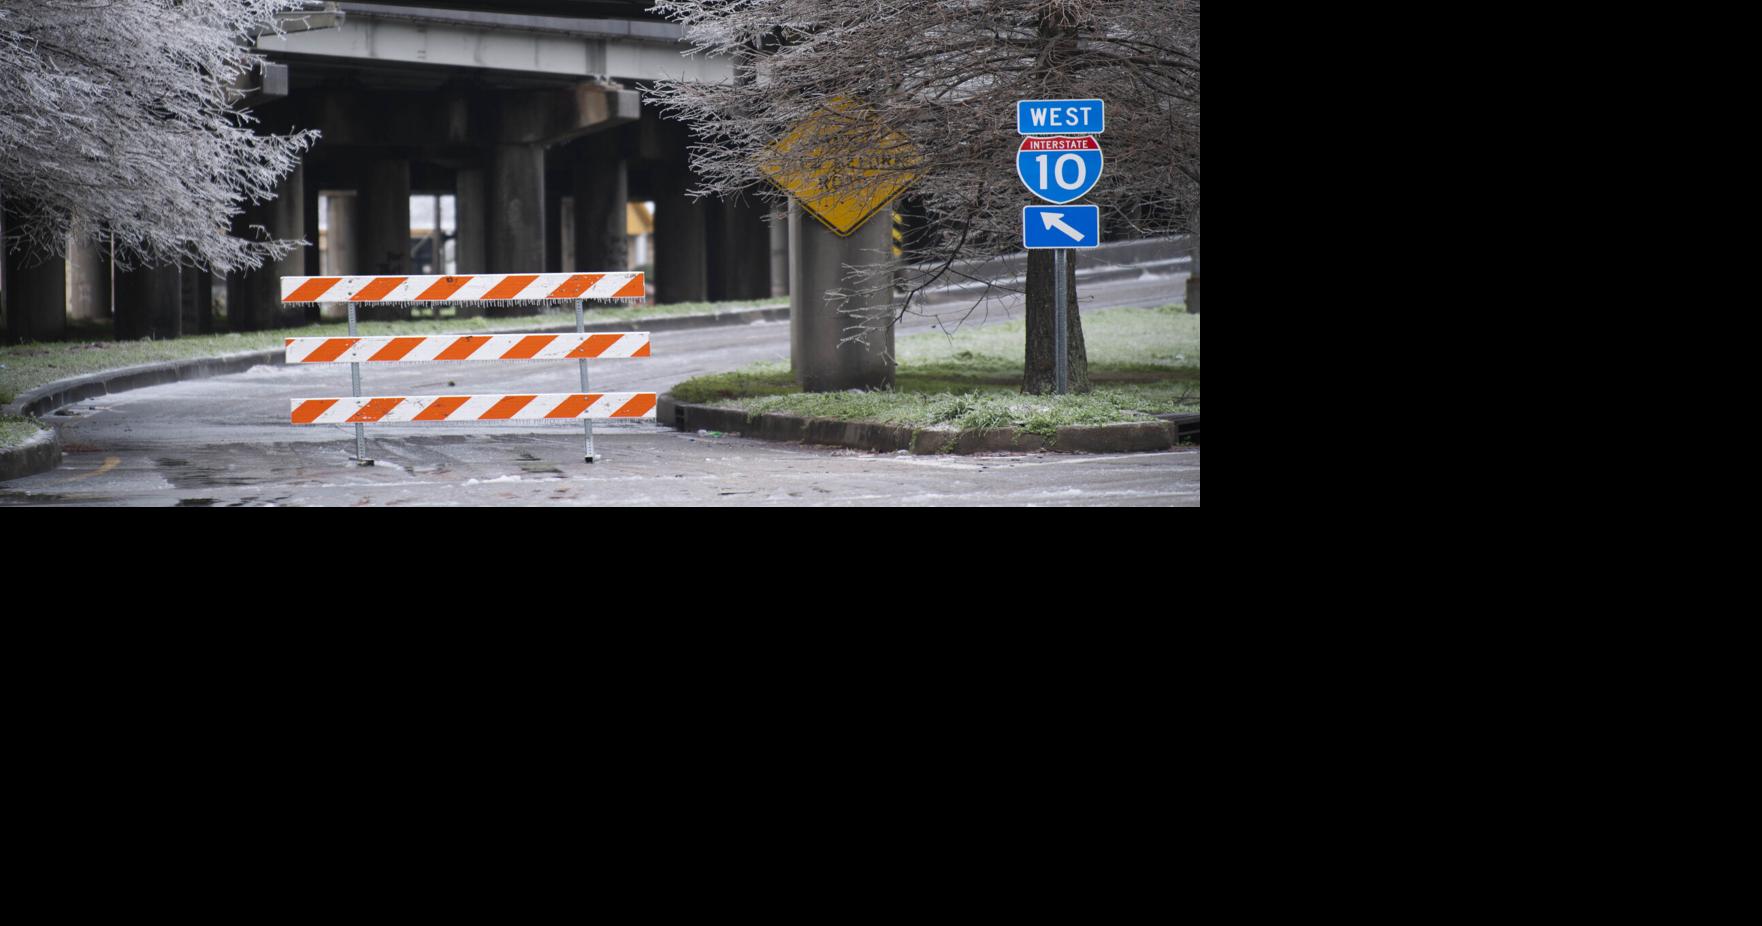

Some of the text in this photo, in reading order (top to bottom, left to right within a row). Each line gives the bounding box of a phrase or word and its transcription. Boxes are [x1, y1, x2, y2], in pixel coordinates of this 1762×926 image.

[1030, 107, 1092, 127] WEST
[1030, 139, 1089, 149] INTERSTATE
[1035, 153, 1087, 190] 10
